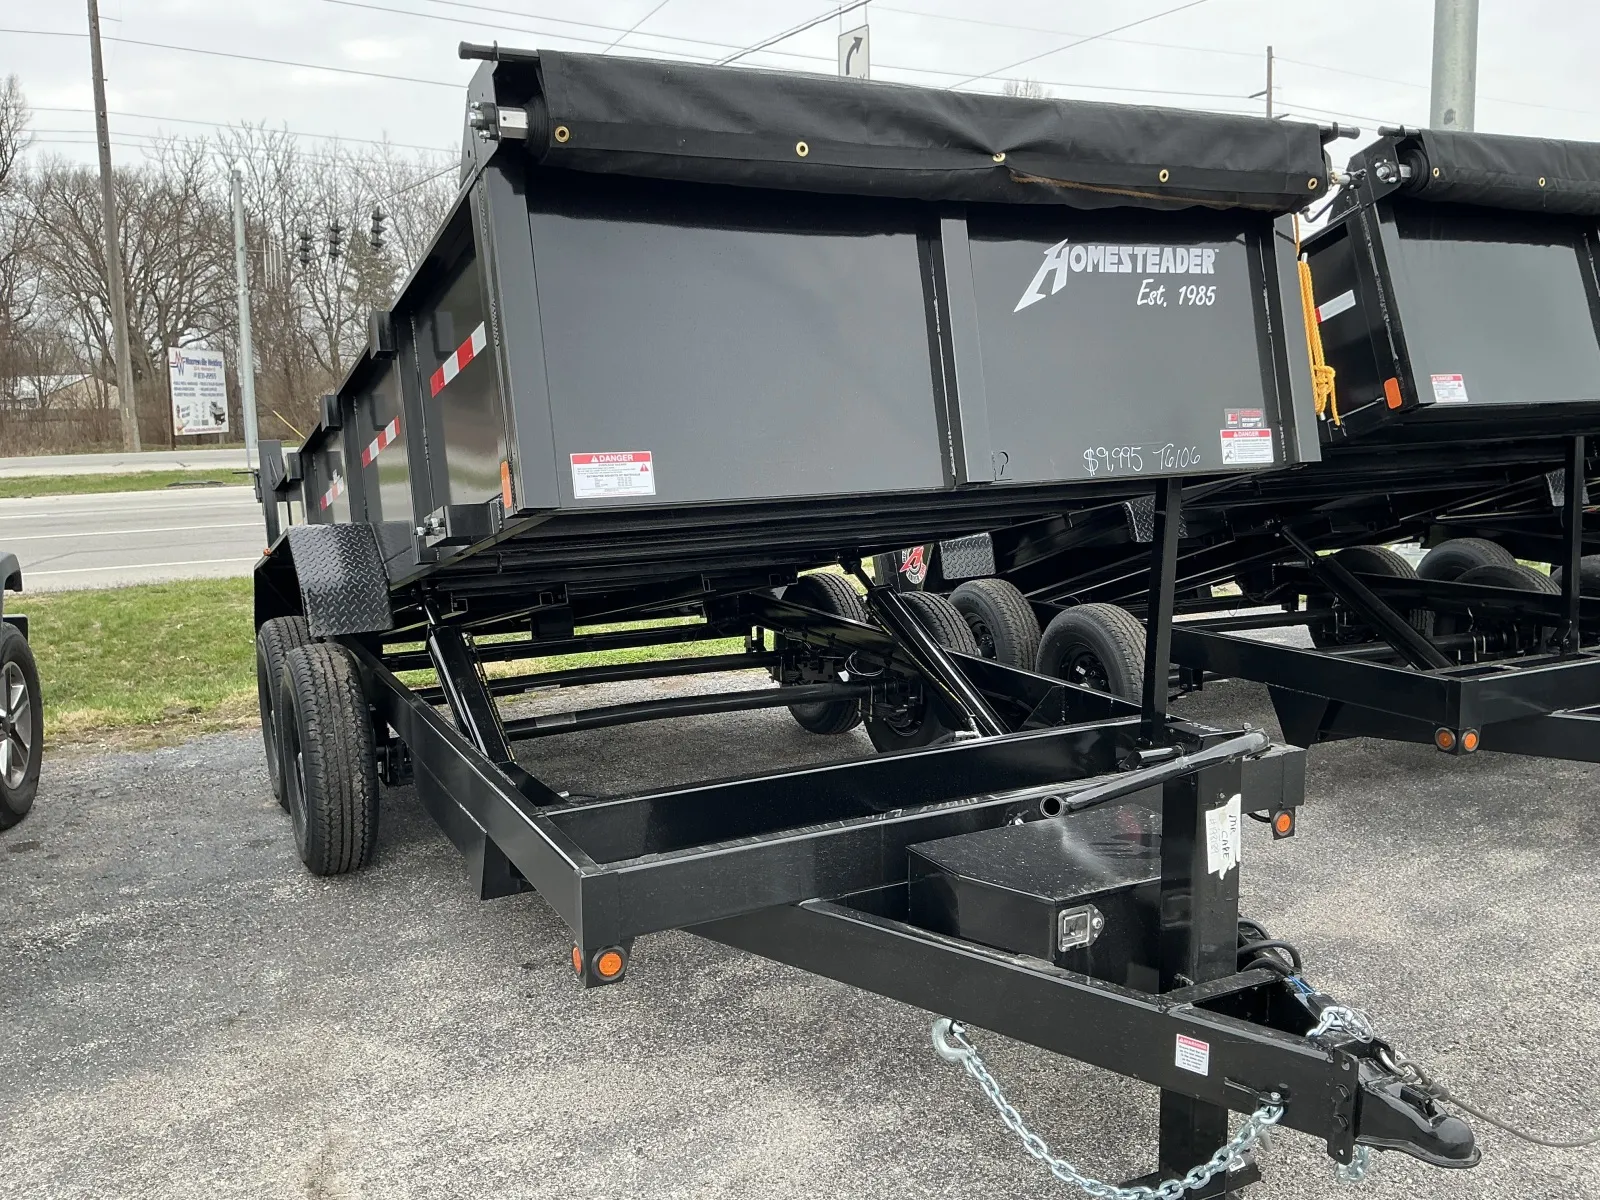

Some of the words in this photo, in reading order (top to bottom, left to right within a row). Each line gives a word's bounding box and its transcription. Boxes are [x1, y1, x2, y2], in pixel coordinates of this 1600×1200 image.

[1013, 238, 1217, 312] HOMESTEADER
[1178, 284, 1217, 306] 1985
[599, 453, 634, 462] DANGER
